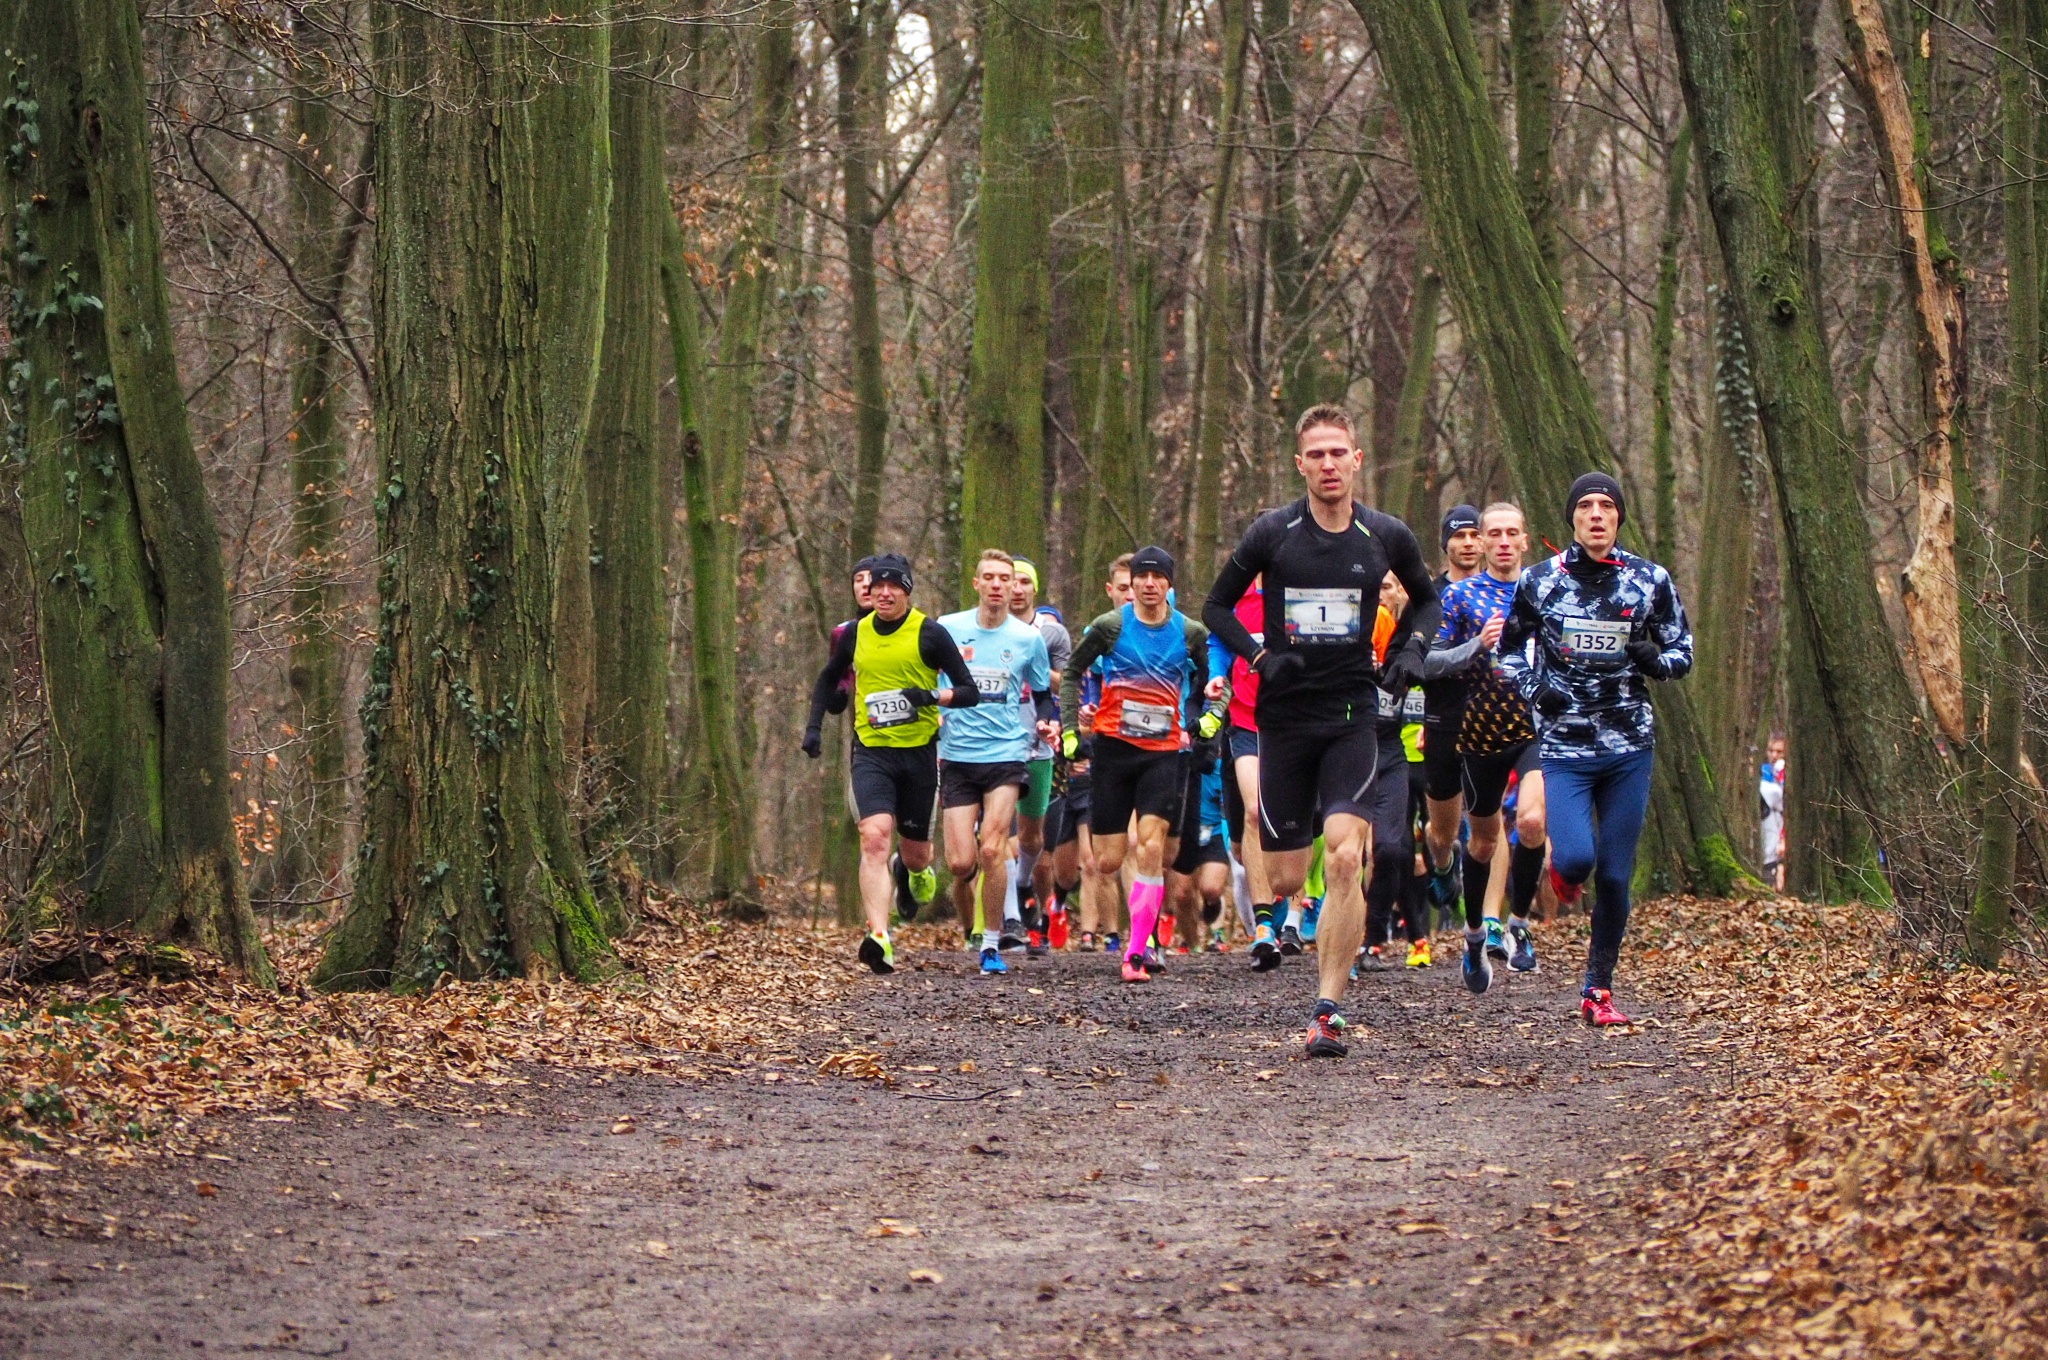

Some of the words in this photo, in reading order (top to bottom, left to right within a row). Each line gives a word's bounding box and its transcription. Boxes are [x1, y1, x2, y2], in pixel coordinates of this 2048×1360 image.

[1318, 606, 1326, 622] 1
[1574, 634, 1617, 651] 1352
[875, 699, 908, 715] 1230
[1405, 701, 1423, 713] 46
[1142, 714, 1150, 725] 4
